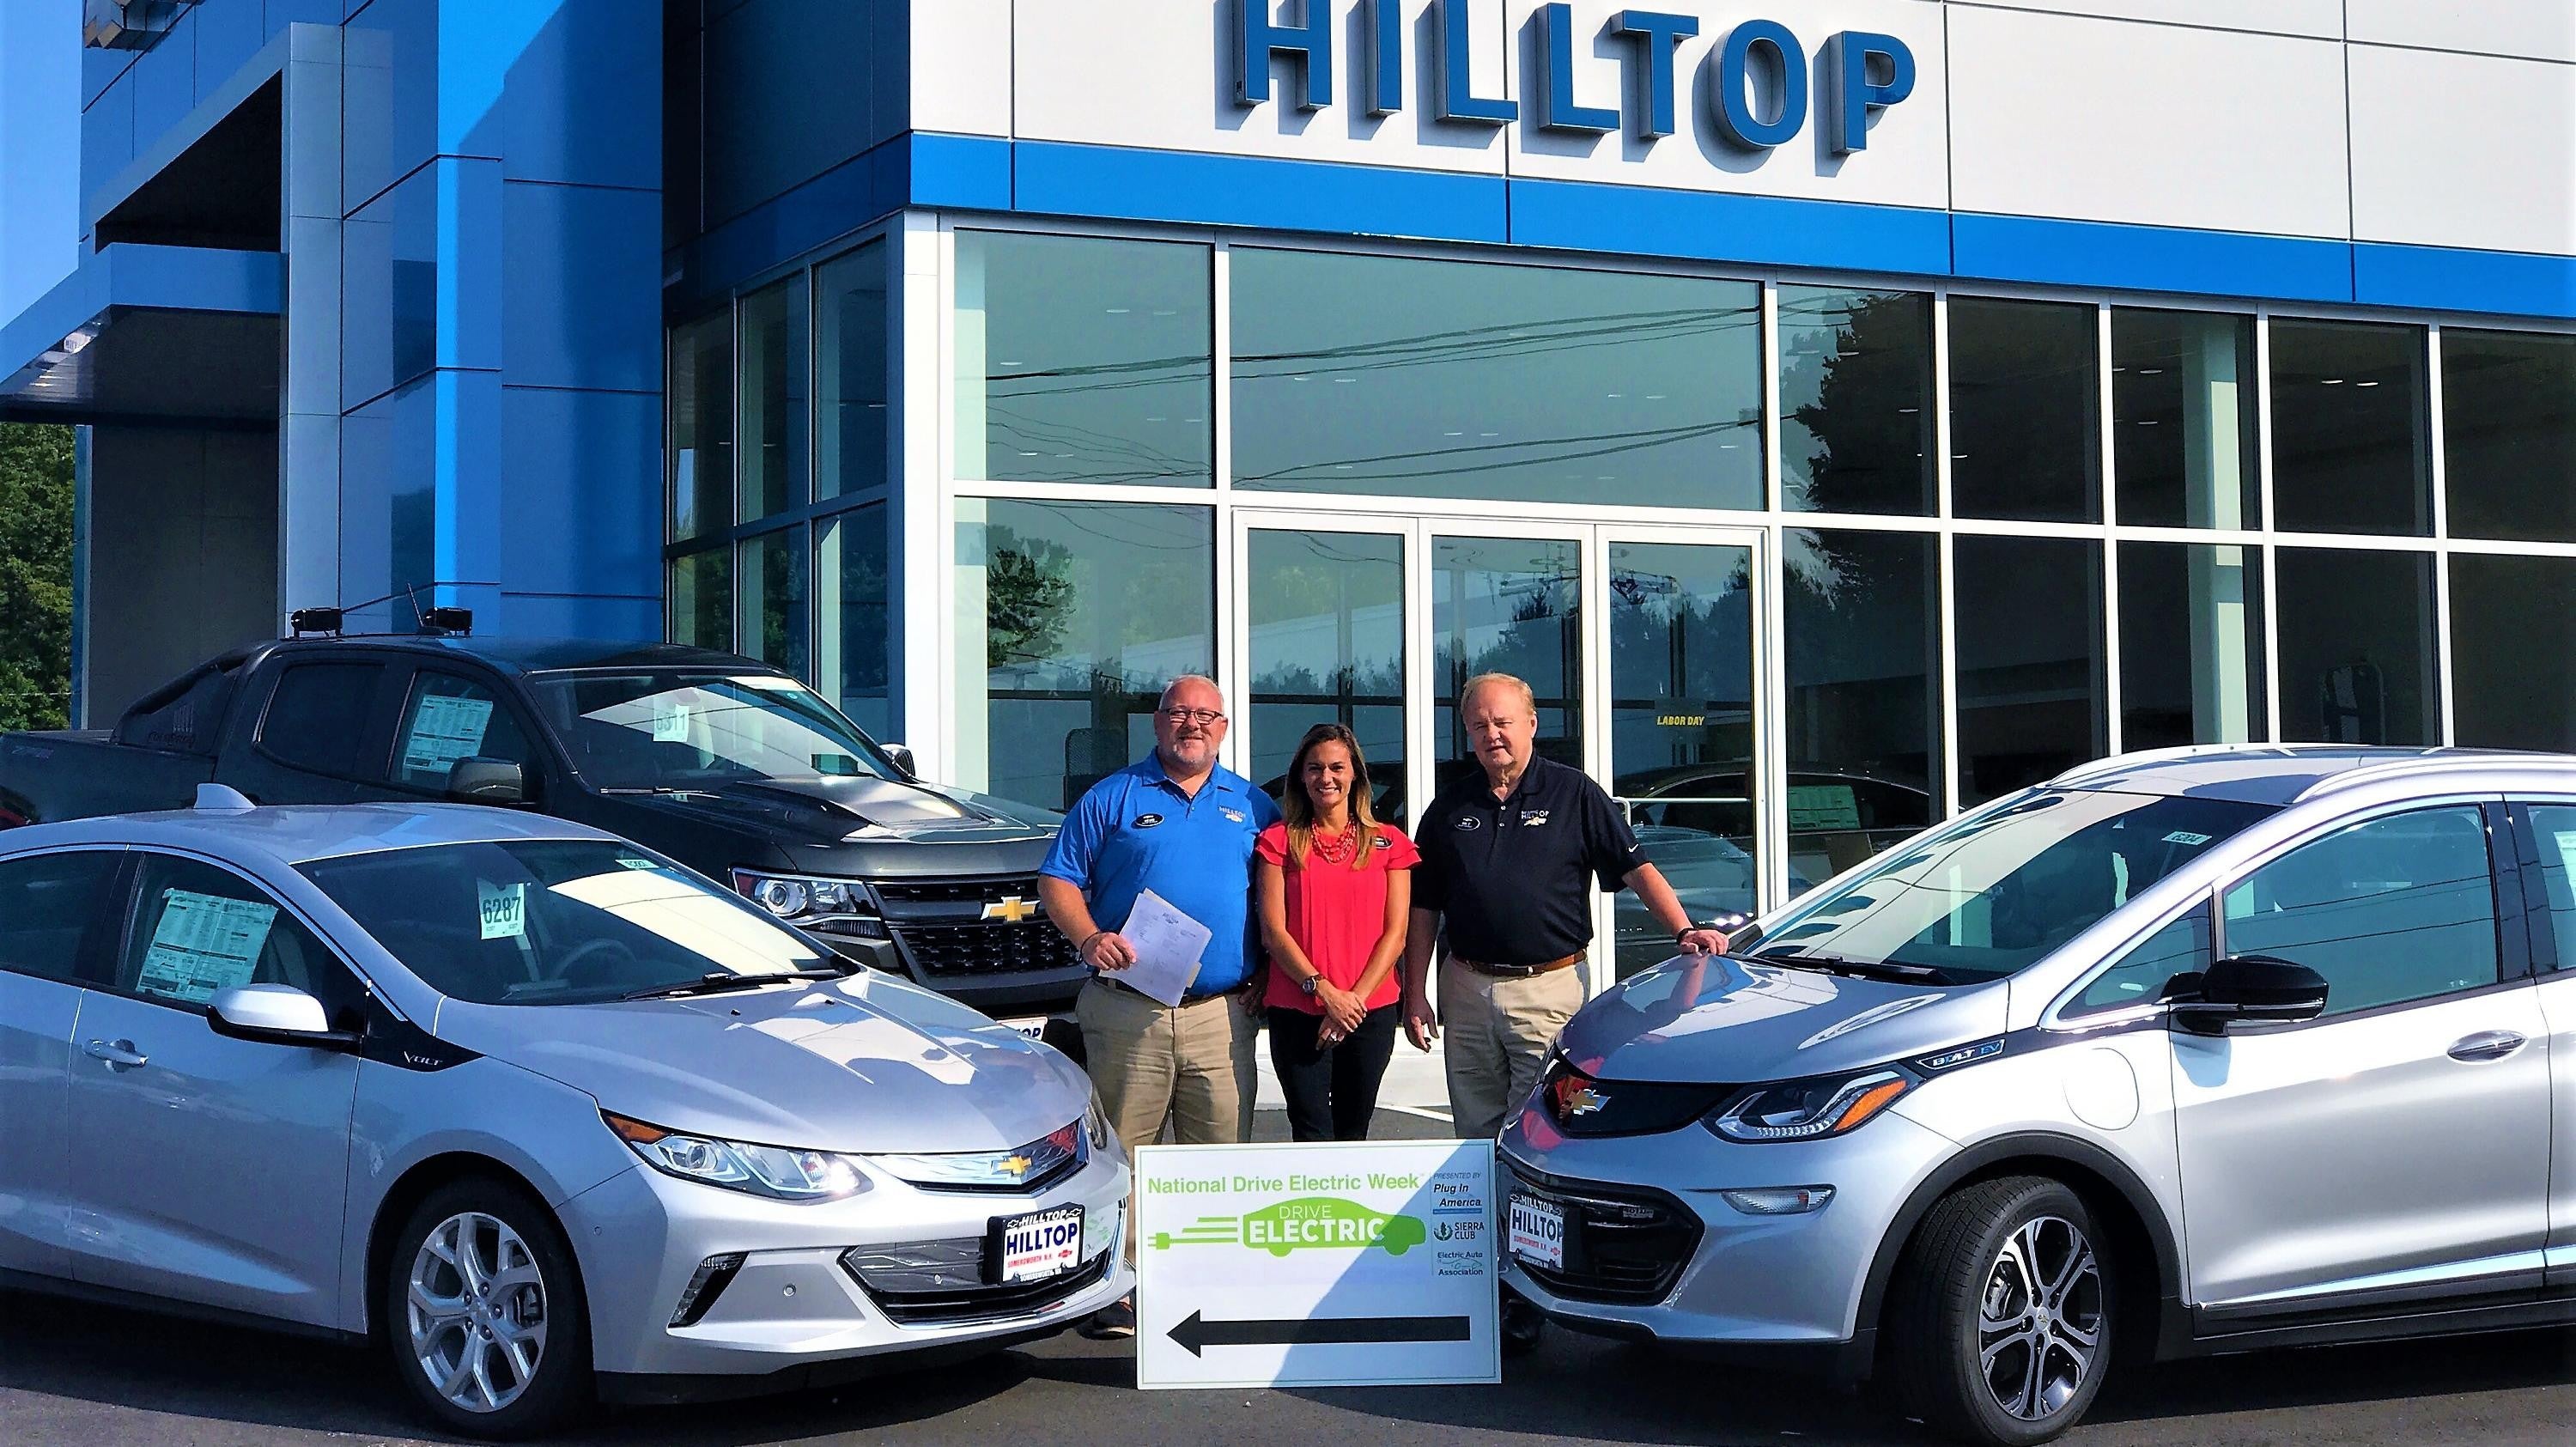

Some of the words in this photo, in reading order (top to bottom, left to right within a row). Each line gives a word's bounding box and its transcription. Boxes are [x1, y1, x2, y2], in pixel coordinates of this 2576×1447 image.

[1236, 0, 1917, 155] HILLTOP
[1657, 715, 1686, 726] LABOR
[1687, 715, 1704, 726] DAY
[483, 897, 521, 923] 6287
[1932, 1049, 1975, 1066] BOLT
[1981, 1043, 2000, 1054] EV
[1148, 1176, 1226, 1194] National
[1233, 1176, 1283, 1193] Drive
[1290, 1174, 1361, 1191] Electric
[1367, 1173, 1419, 1189] Week
[1433, 1183, 1456, 1195] Plug
[1459, 1183, 1469, 1193] In
[1439, 1198, 1481, 1207] America
[1521, 1195, 1553, 1213] HILLTOP
[1021, 1210, 1067, 1226] HILLTOP
[1279, 1205, 1332, 1219] DRIVE
[1249, 1218, 1385, 1243] ELECTRIC
[1454, 1222, 1485, 1231] SIERRA
[1512, 1208, 1563, 1243] HILLTOP
[1006, 1223, 1078, 1255] HILLTOP
[1454, 1231, 1476, 1240] CLUB
